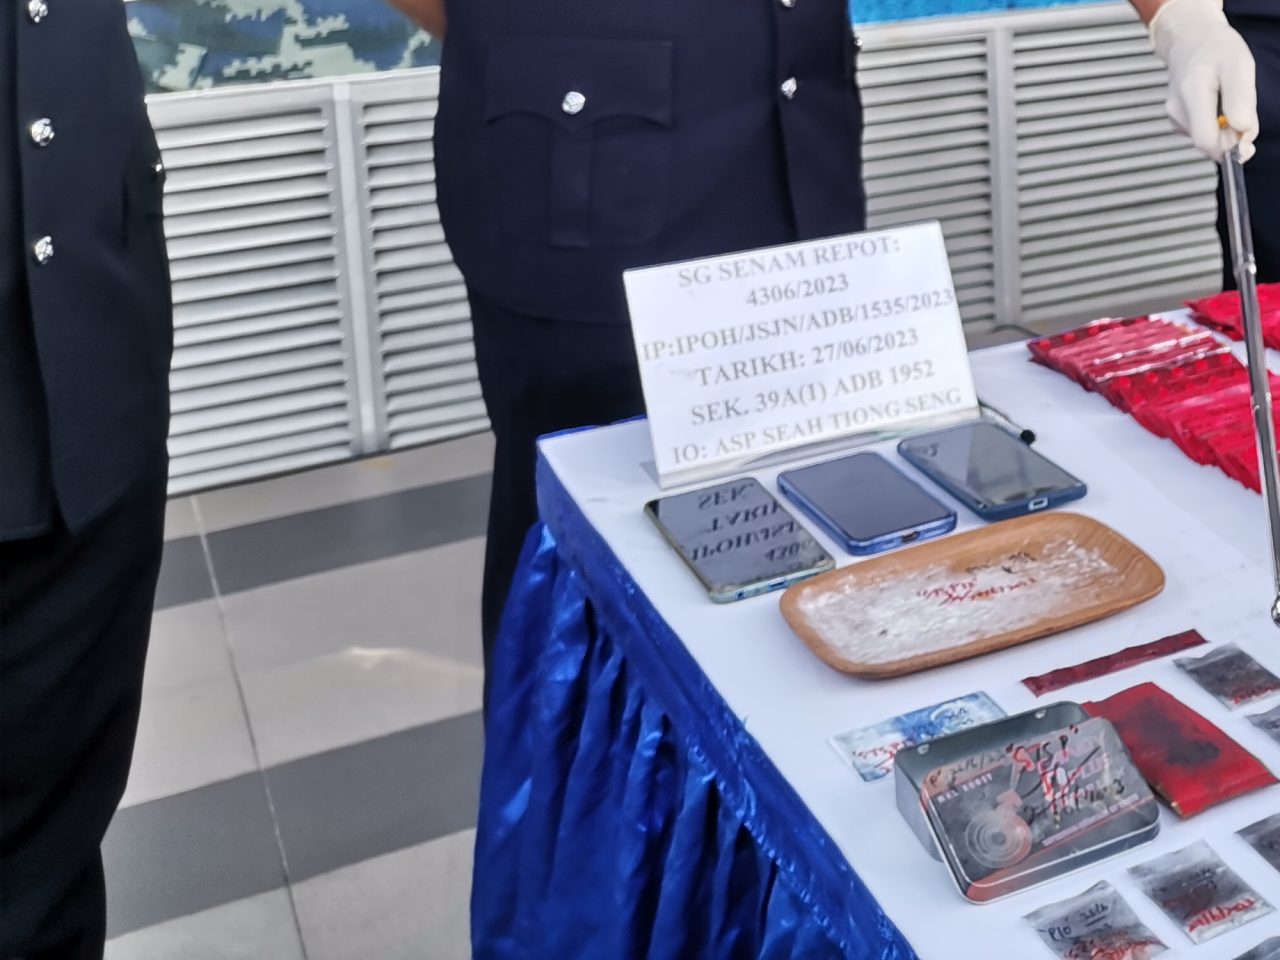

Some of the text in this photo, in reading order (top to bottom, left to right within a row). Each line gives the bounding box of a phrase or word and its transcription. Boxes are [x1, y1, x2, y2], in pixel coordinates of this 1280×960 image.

[678, 236, 901, 288] SG SENAM REPOT:
[746, 272, 849, 307] 4306/2023
[696, 328, 919, 387] TARIKH: 27/06/2023
[691, 399, 749, 426] SEK.
[834, 369, 885, 397] ADB
[890, 358, 936, 386] 1952
[672, 387, 963, 465] IO: ASP SEAH TIONG SENG
